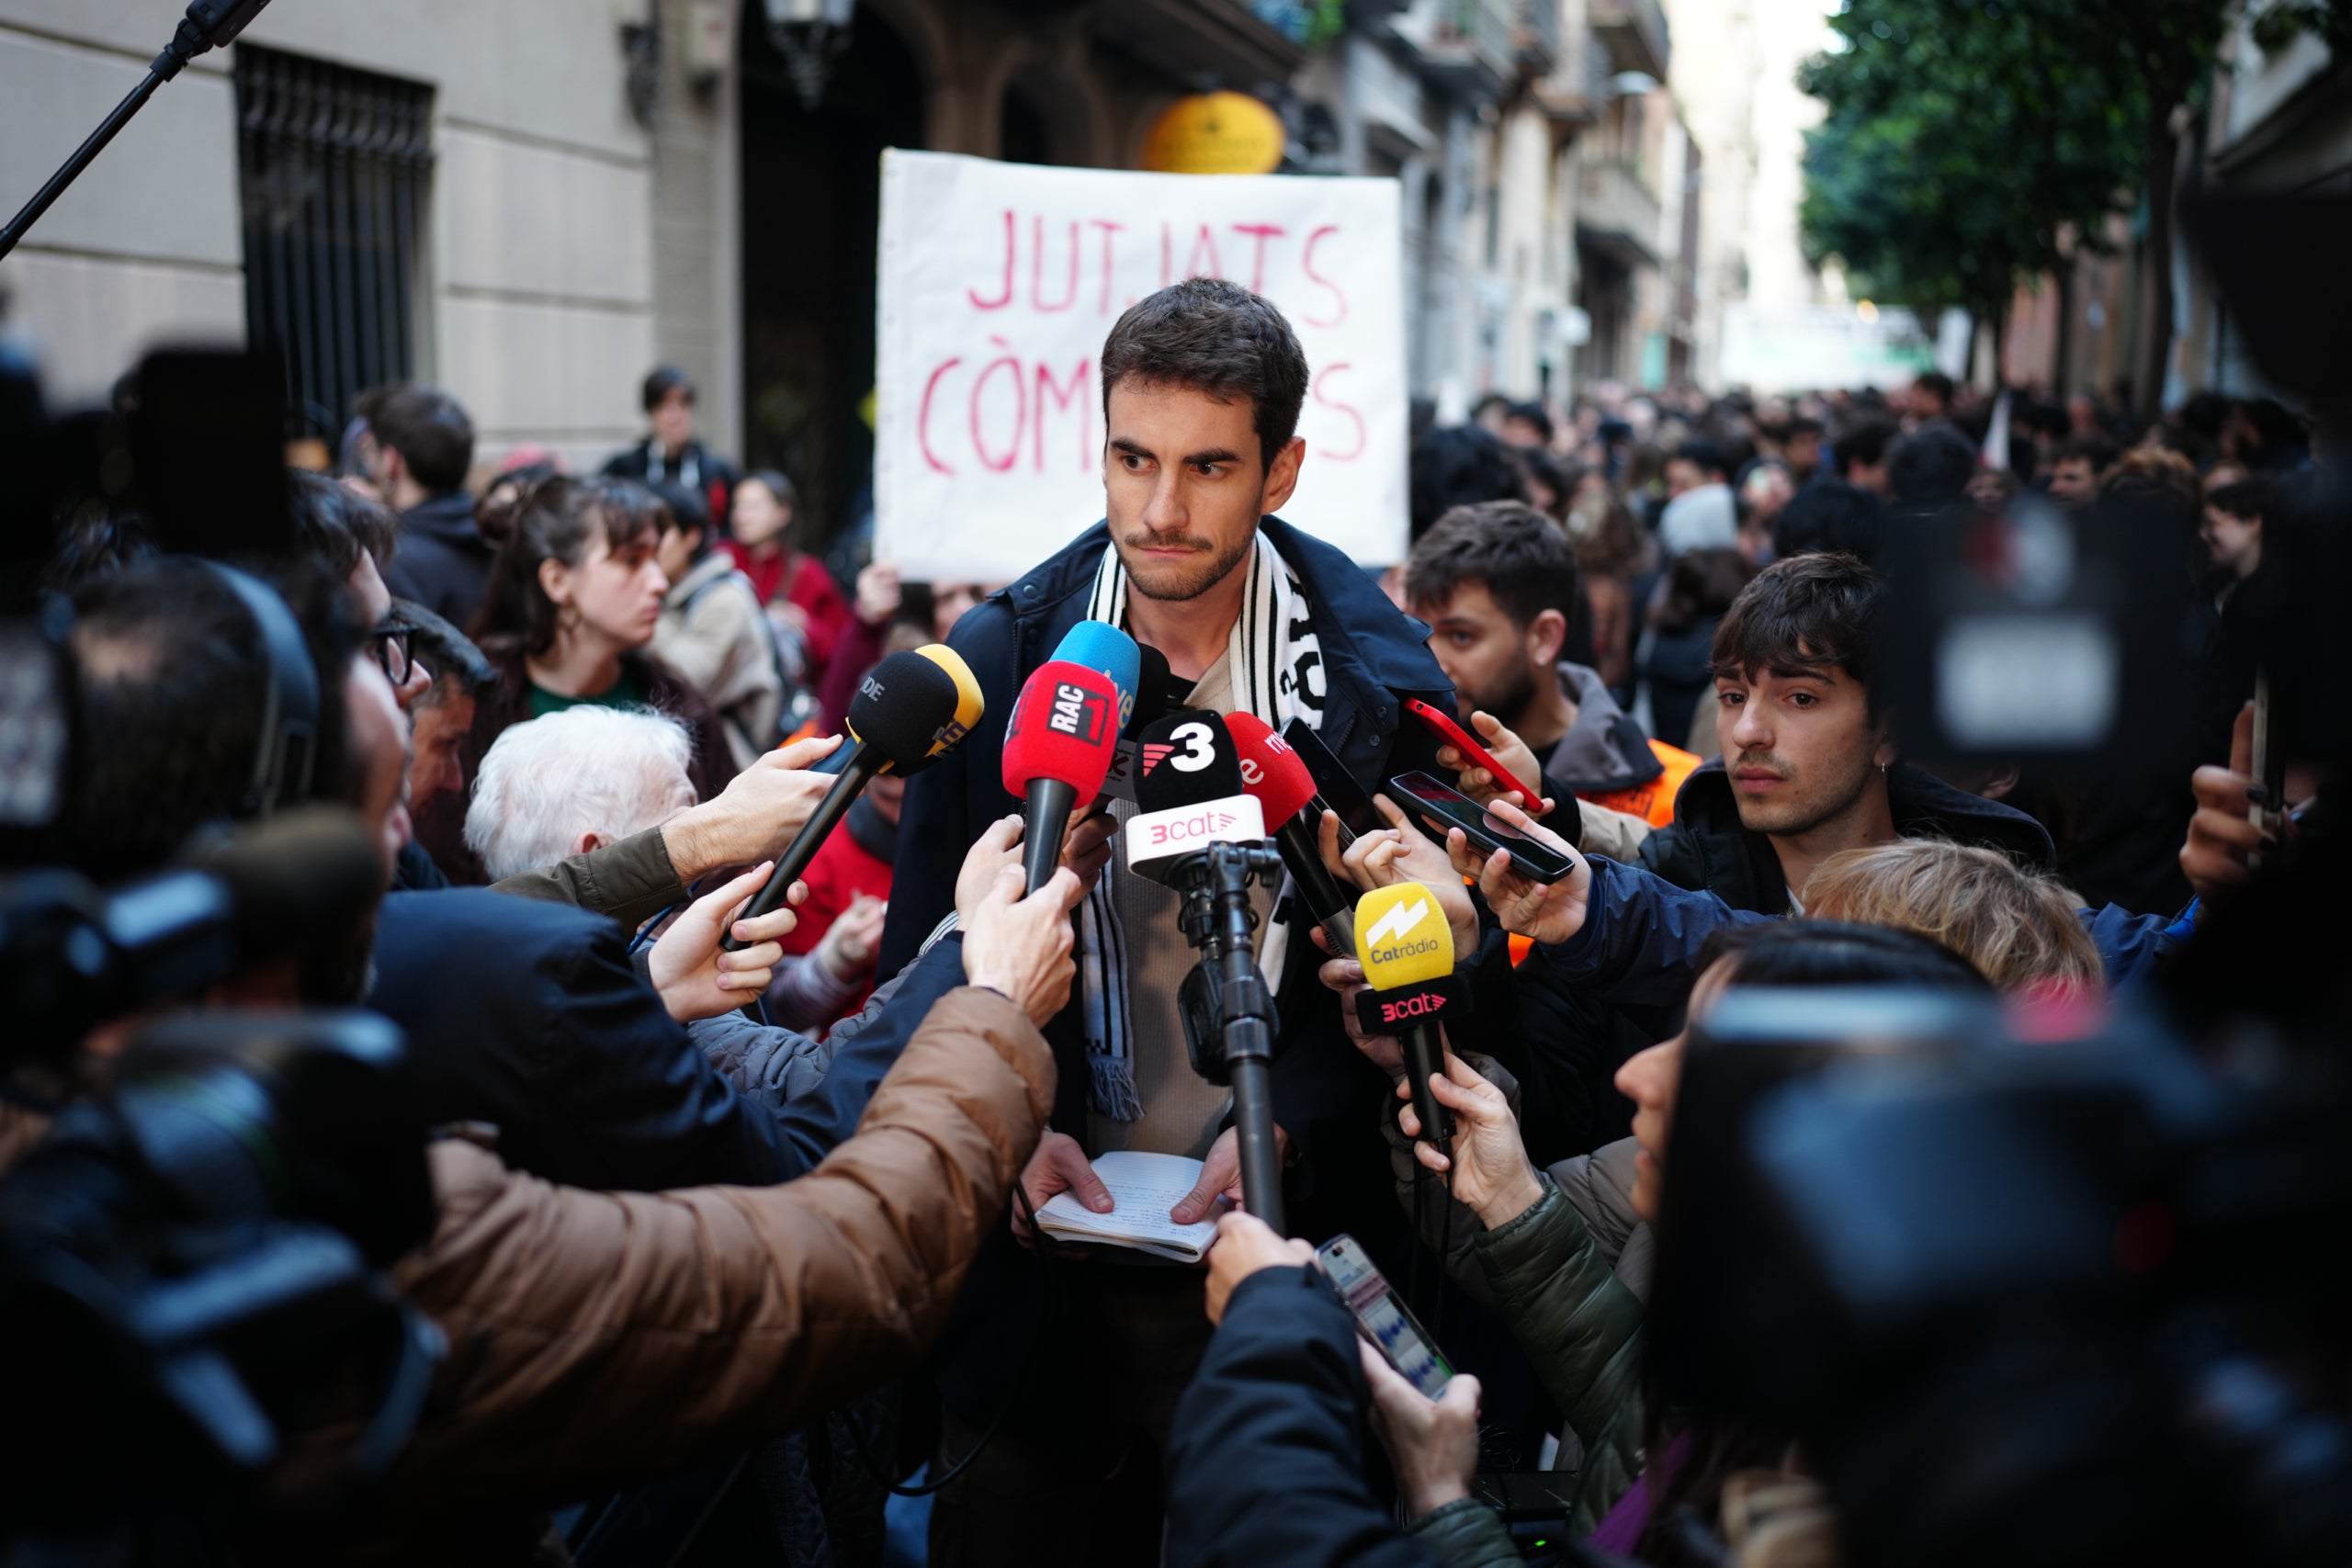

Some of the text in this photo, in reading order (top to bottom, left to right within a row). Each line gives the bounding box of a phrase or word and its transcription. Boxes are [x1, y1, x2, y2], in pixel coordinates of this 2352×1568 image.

[1169, 722, 1216, 773] 3
[1150, 811, 1216, 845] 3cat
[1371, 937, 1440, 964] Catràdio
[1381, 992, 1433, 1022] 3cat
